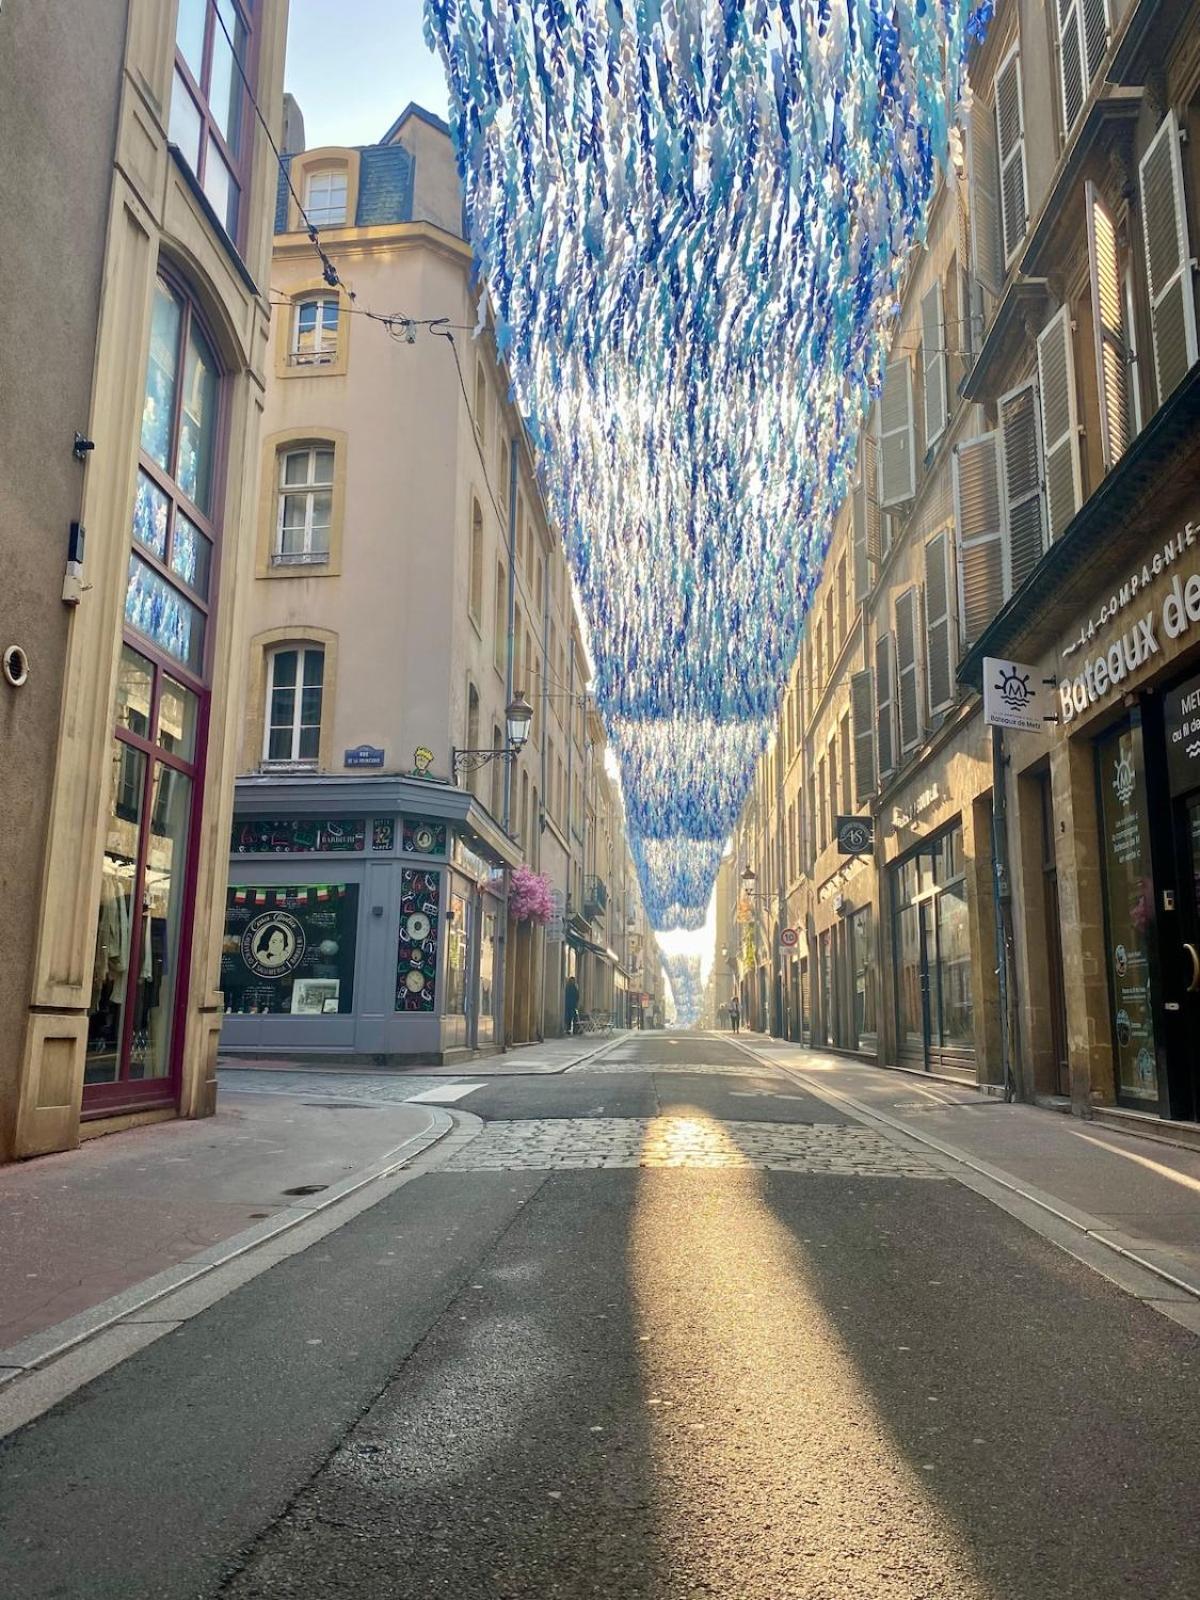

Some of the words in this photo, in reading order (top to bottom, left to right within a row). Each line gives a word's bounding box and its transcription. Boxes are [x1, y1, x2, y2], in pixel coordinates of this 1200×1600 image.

[1078, 619, 1096, 645] LA
[1100, 521, 1195, 624] COMPAGNIE
[1059, 610, 1160, 725] Bateaux
[1163, 574, 1200, 639] de
[1172, 729, 1182, 743] au
[783, 932, 795, 942] 10
